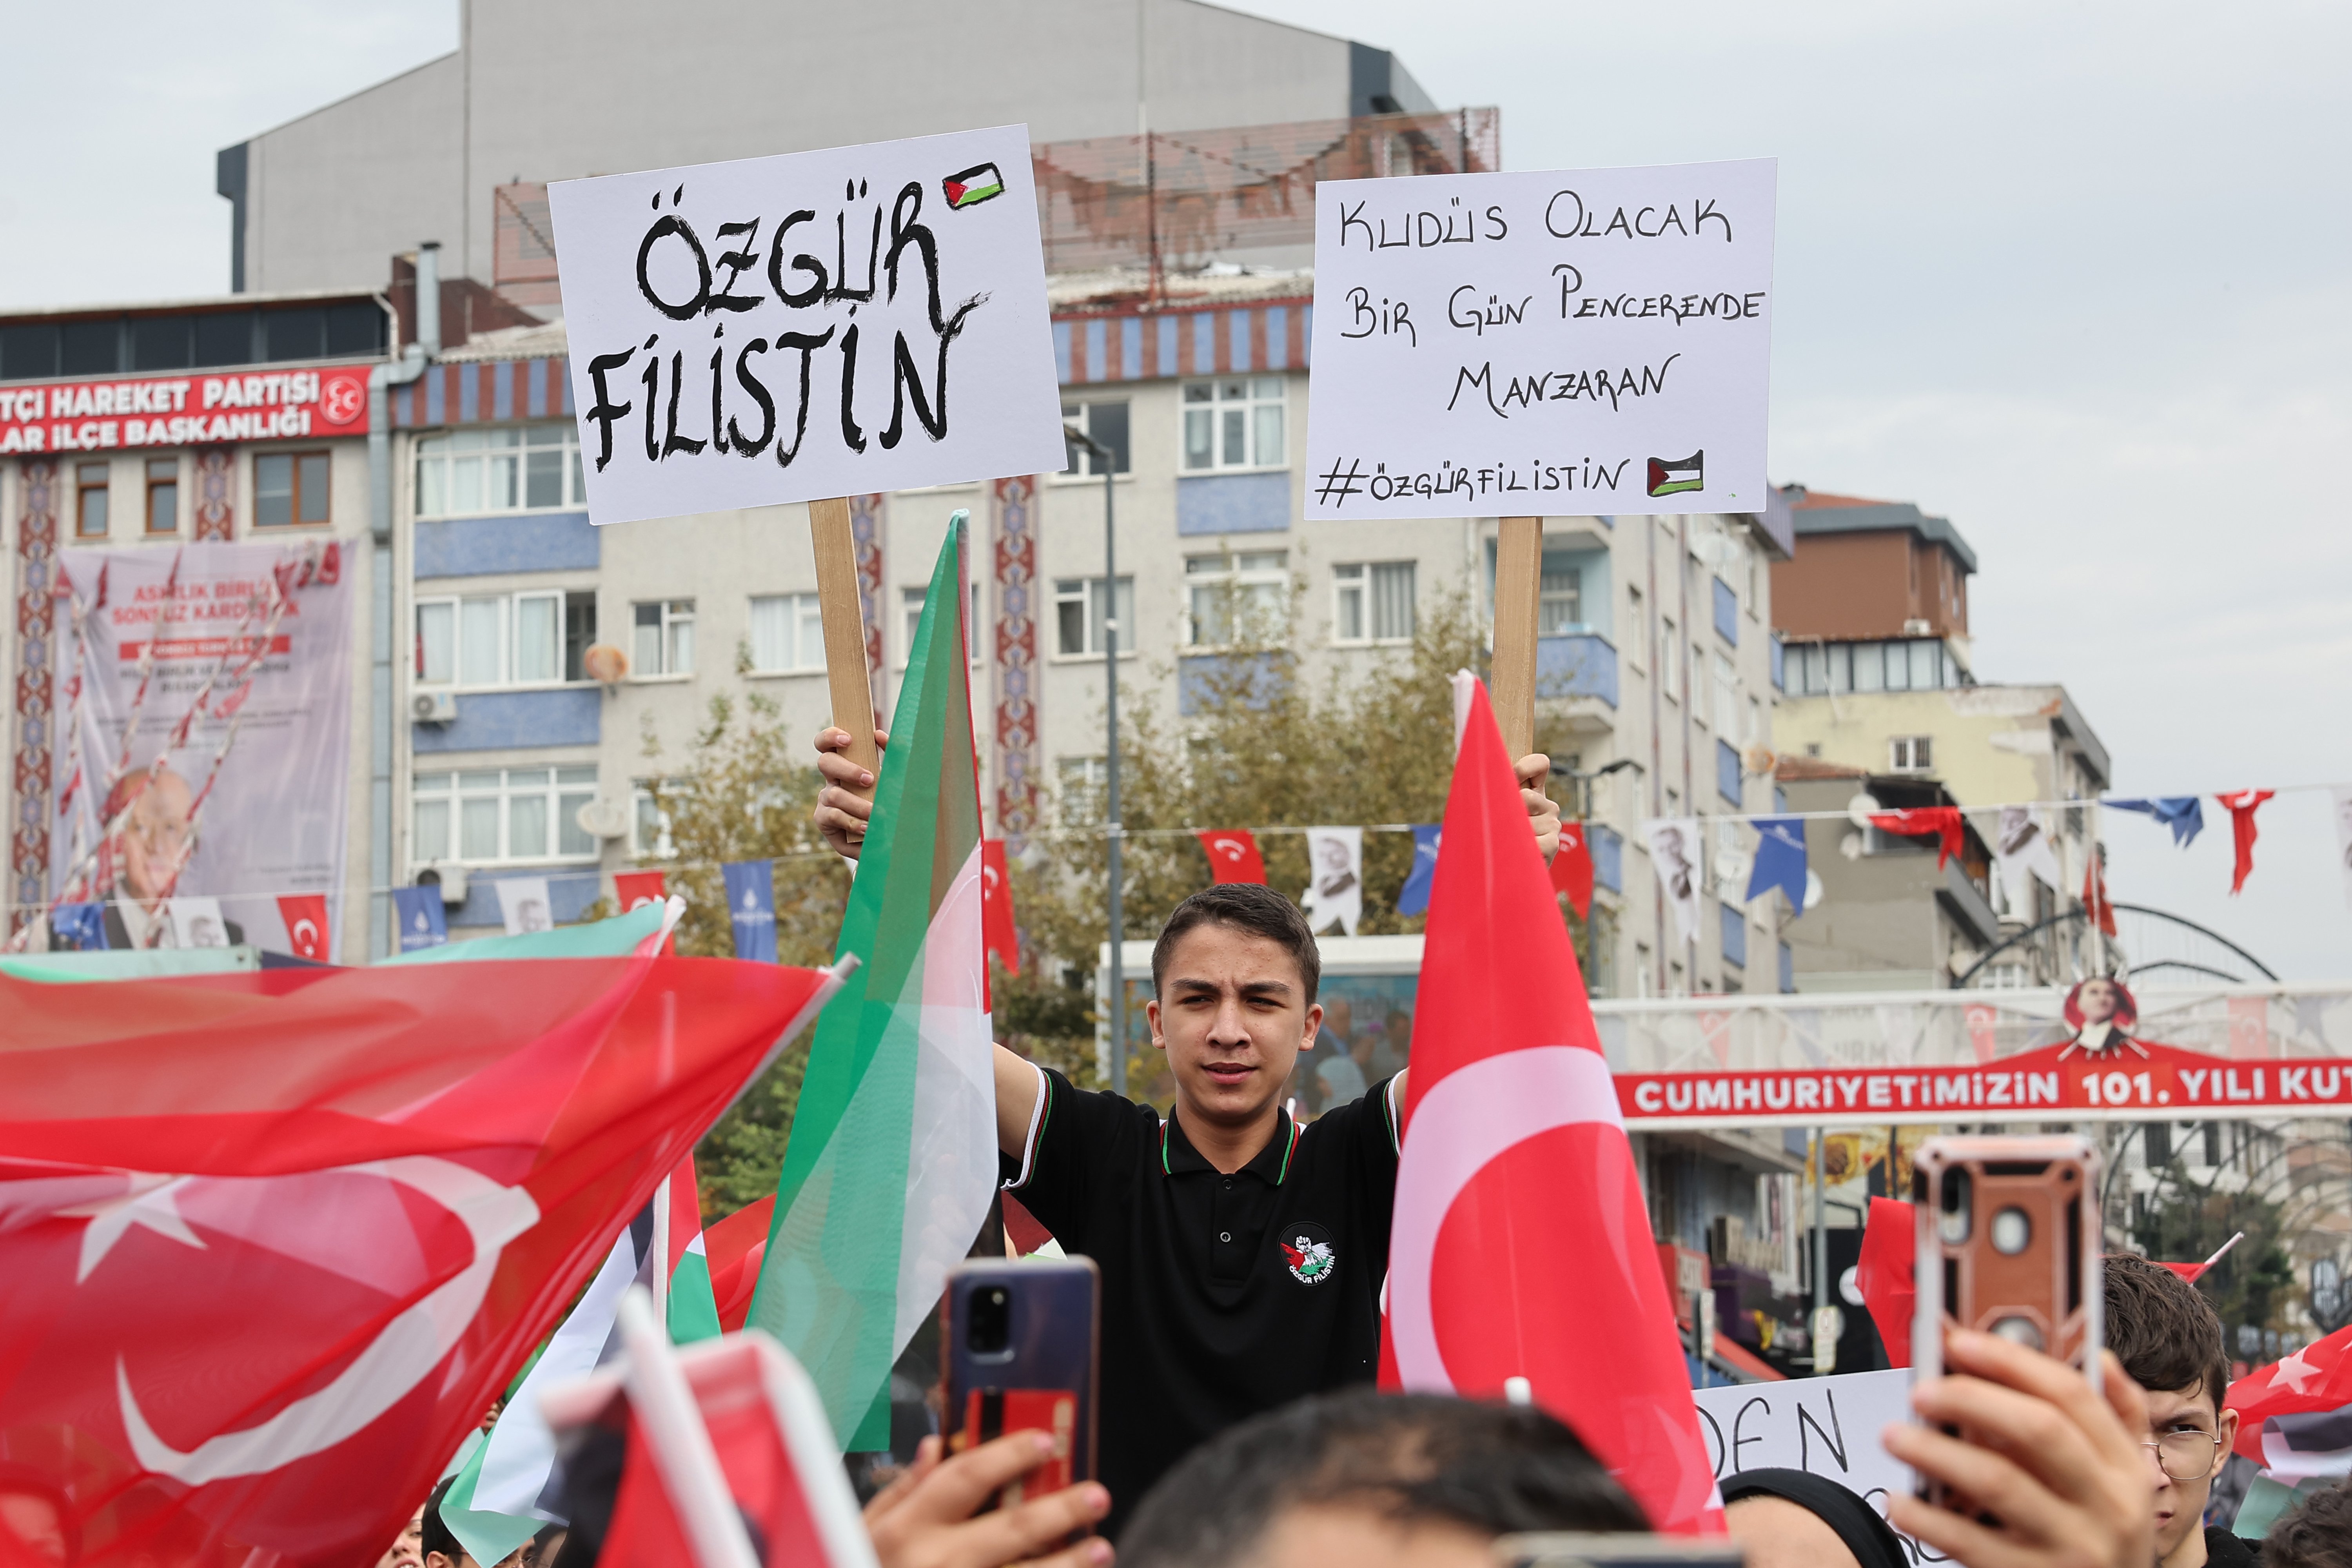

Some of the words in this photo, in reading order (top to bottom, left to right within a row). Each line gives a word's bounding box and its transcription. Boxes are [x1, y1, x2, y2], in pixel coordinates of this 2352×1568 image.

[1341, 196, 1508, 252] KUDÜS
[1545, 190, 1731, 243] OLACAK
[637, 177, 994, 340] ÖZGÜR
[1341, 287, 1416, 347] BİR
[1448, 285, 1532, 336] GÜN
[1552, 264, 1766, 326] PENCERENDE
[51, 379, 191, 419] HAREKET
[584, 305, 951, 473] FİLİSTİN
[1447, 354, 1681, 419] MANZARAN
[124, 404, 312, 445] BAŞKANLIĞI
[1315, 457, 1630, 508] #ÖZGÜRFİLİSTİN
[1635, 1071, 2058, 1112] CUMHURİYETİMİZİN
[2081, 1071, 2170, 1105] 101.
[2178, 1067, 2266, 1102] YILI
[1289, 1265, 1312, 1284] ÖZGÜR
[1314, 1255, 1335, 1283] FİLİSTİN
